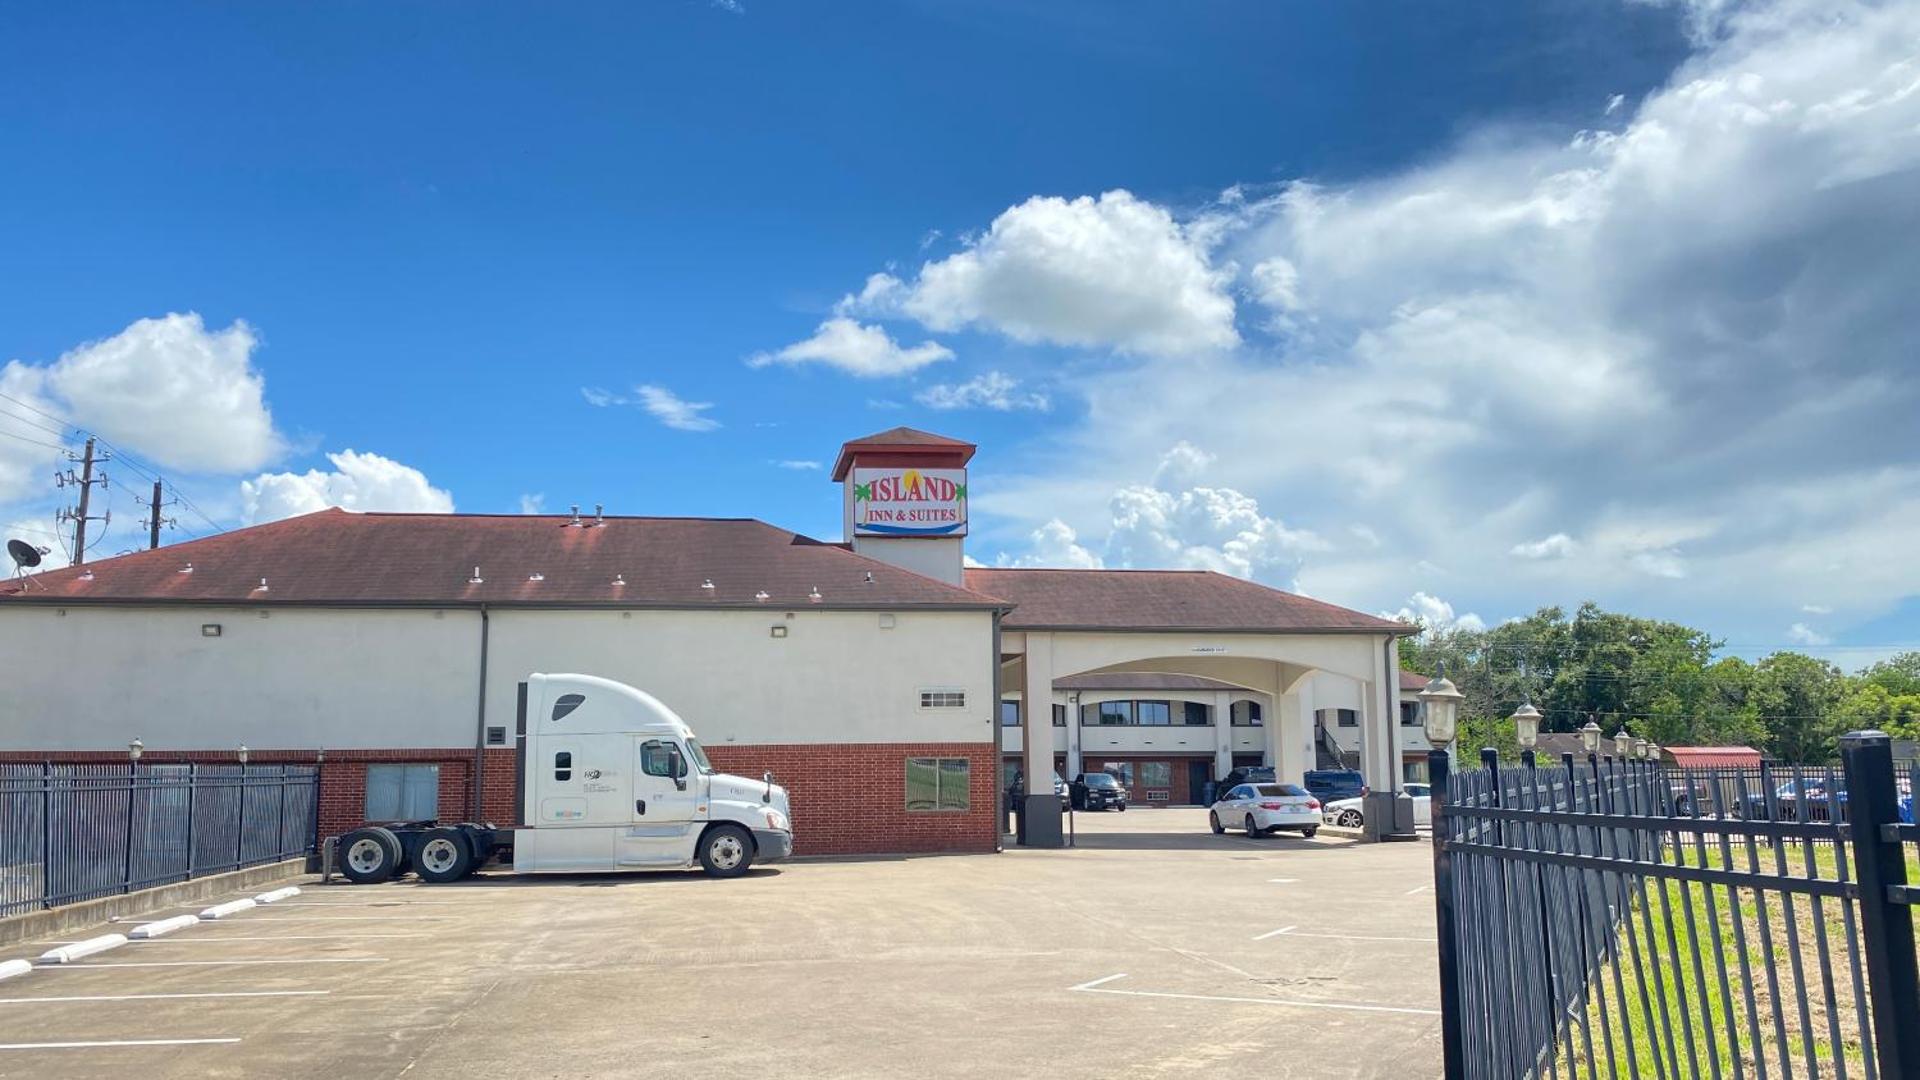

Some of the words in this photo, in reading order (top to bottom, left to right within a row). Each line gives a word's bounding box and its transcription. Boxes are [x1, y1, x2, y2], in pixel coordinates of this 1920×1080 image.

[869, 476, 956, 501] ISLAND
[869, 510, 893, 521] INN
[896, 510, 906, 521] &
[909, 508, 956, 521] SUITES
